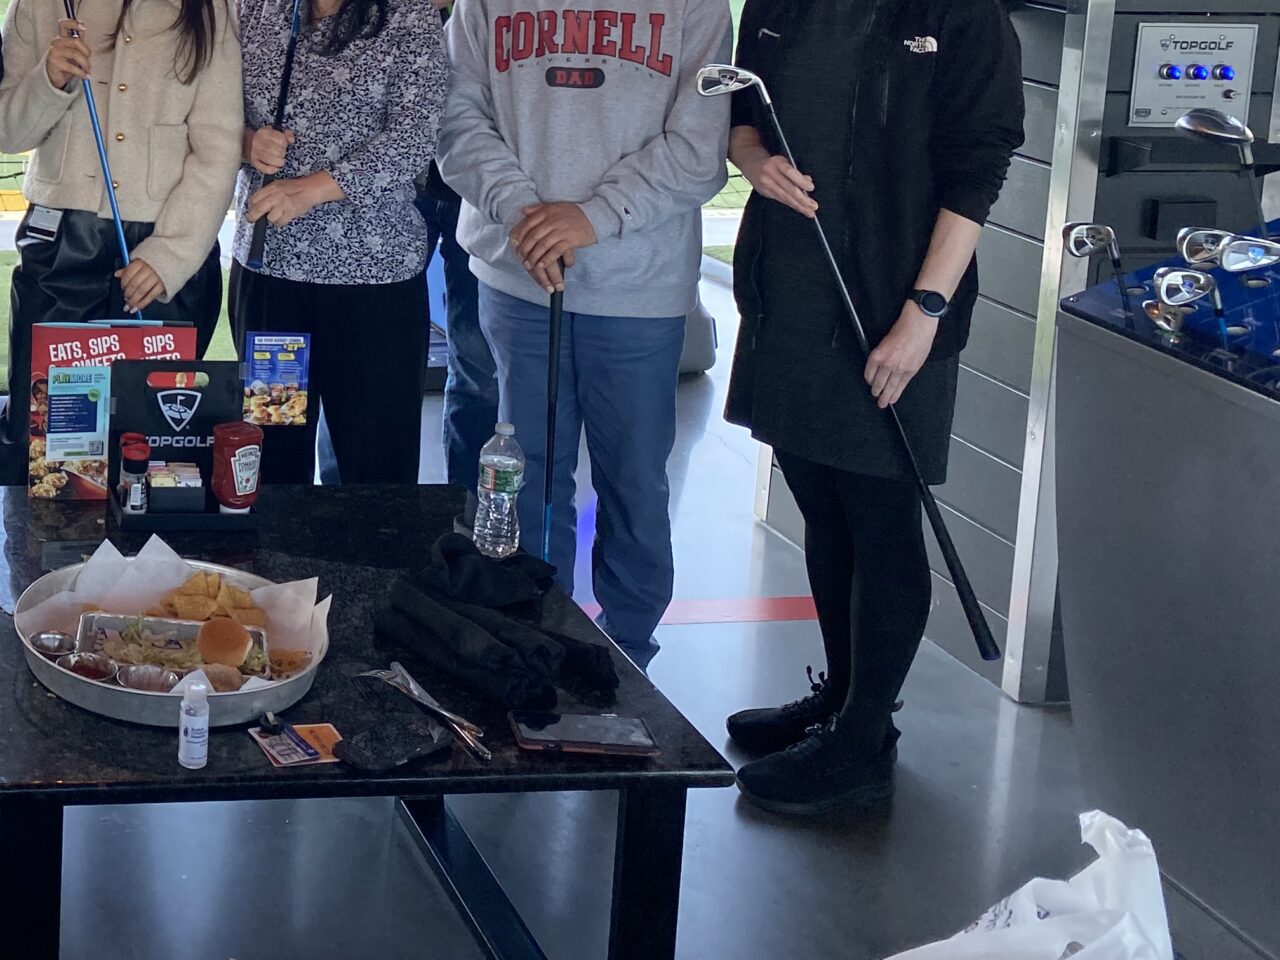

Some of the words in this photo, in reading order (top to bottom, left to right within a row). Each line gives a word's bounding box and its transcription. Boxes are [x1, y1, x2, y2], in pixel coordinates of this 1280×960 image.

[494, 9, 674, 78] CORNELL
[1172, 40, 1234, 51] TOPGOLF
[555, 70, 595, 85] DAD
[48, 341, 87, 362] EATS,
[88, 334, 121, 356] SIPS
[143, 333, 176, 354] SIPS
[146, 435, 215, 448] OPGOLF
